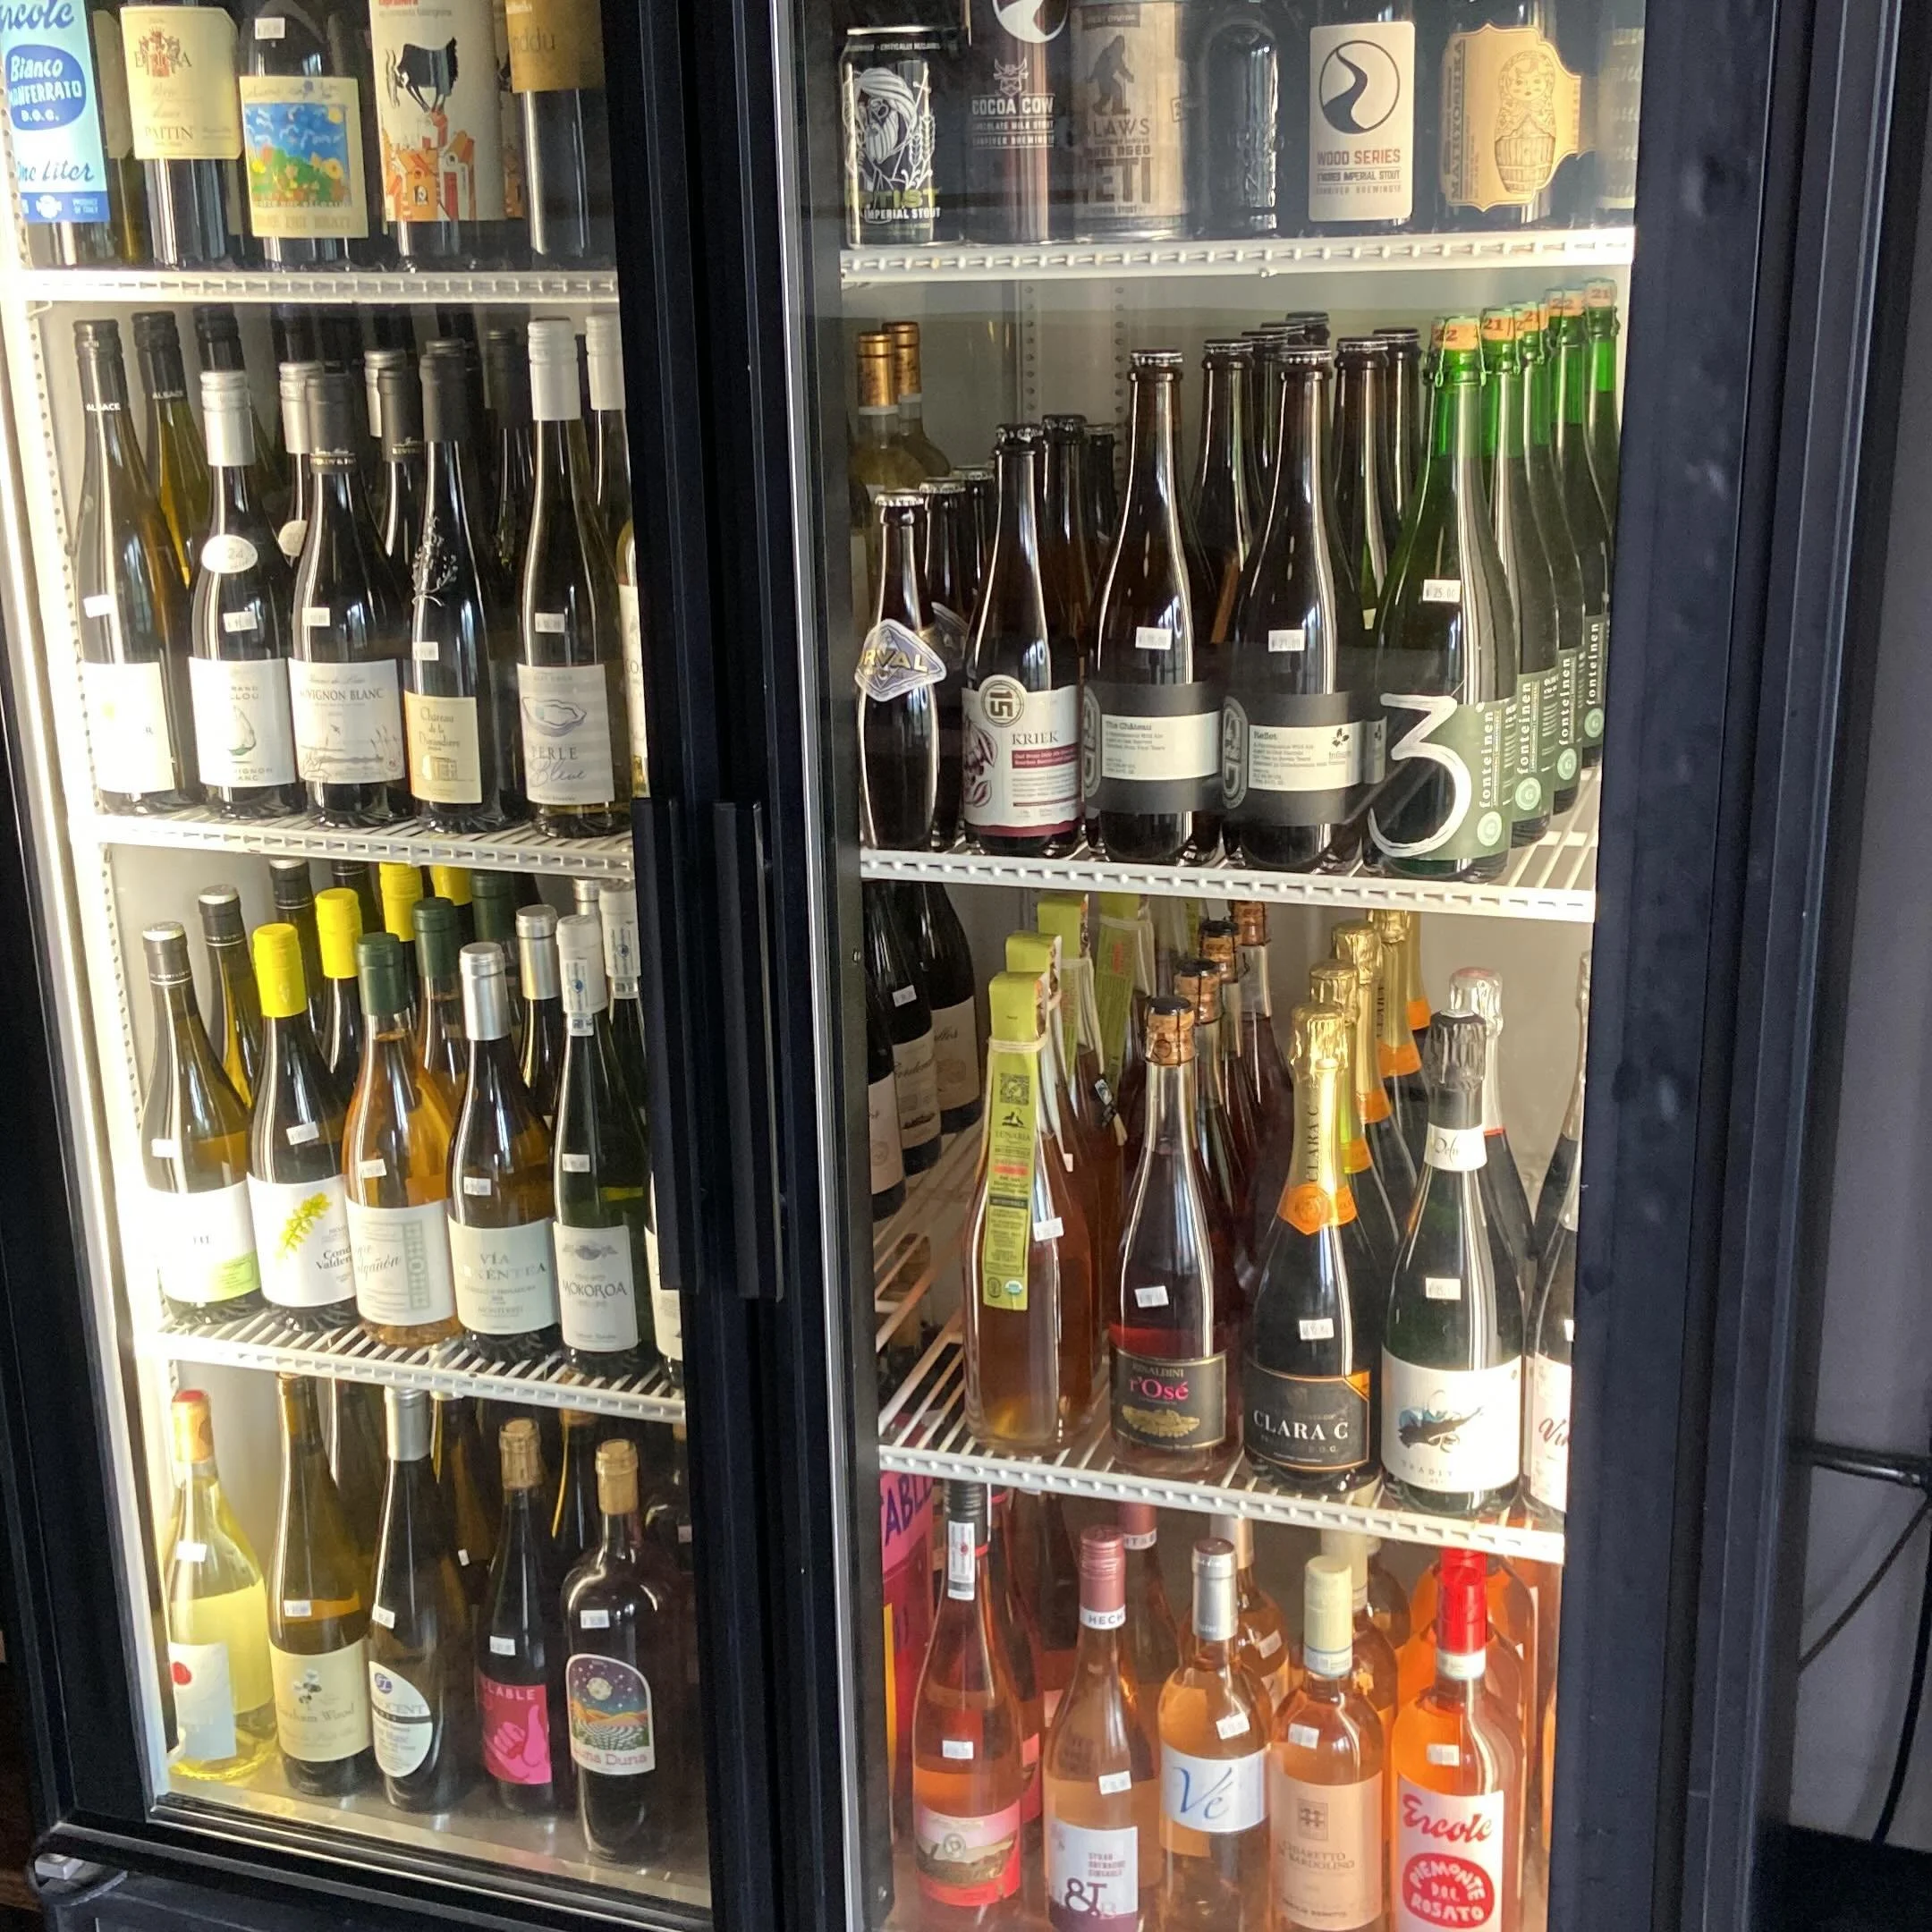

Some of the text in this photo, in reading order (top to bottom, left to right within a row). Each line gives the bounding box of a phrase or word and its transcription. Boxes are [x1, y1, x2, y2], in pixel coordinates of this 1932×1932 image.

[11, 55, 64, 82] Bianco
[971, 96, 1054, 115] COCOA COW
[1317, 147, 1402, 166] WOOD SERIES
[911, 207, 941, 219] STOUT
[86, 402, 122, 412] ALSACE
[860, 647, 928, 673] RVAL
[1586, 623, 1599, 706] fonteinen
[349, 687, 386, 701] BLANC
[1559, 657, 1572, 746] fonteinen
[1012, 731, 1059, 745] KRIEK
[1517, 682, 1531, 775] fonteinen
[1479, 710, 1494, 809] fonteinen
[1253, 1410, 1326, 1440] CLARA
[1334, 1422, 1349, 1439] C
[1402, 1793, 1492, 1843] Ercole
[1410, 1860, 1487, 1901] PIEMONTE
[1411, 1892, 1485, 1921] ROSATO
